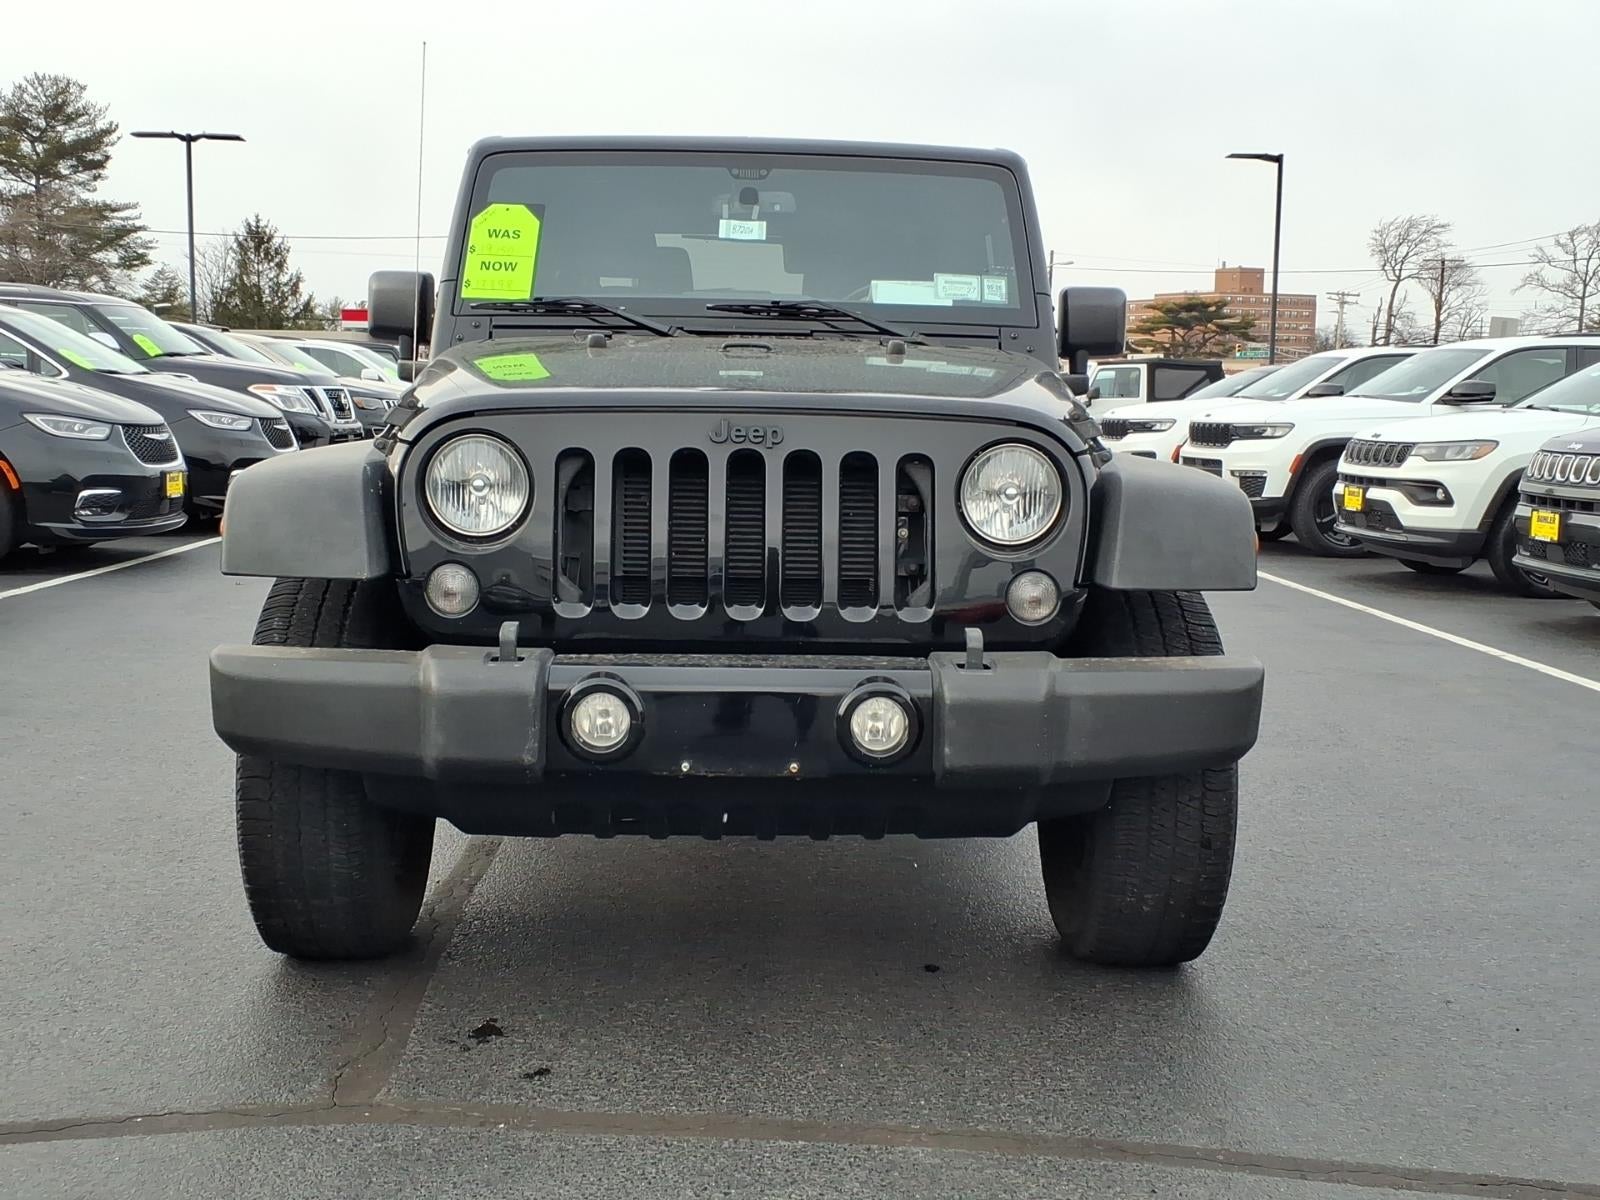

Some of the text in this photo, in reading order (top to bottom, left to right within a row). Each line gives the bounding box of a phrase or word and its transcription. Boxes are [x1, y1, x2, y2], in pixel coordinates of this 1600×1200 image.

[487, 228, 521, 240] WAS
[479, 260, 518, 272] NOW
[708, 417, 784, 449] Jeep
